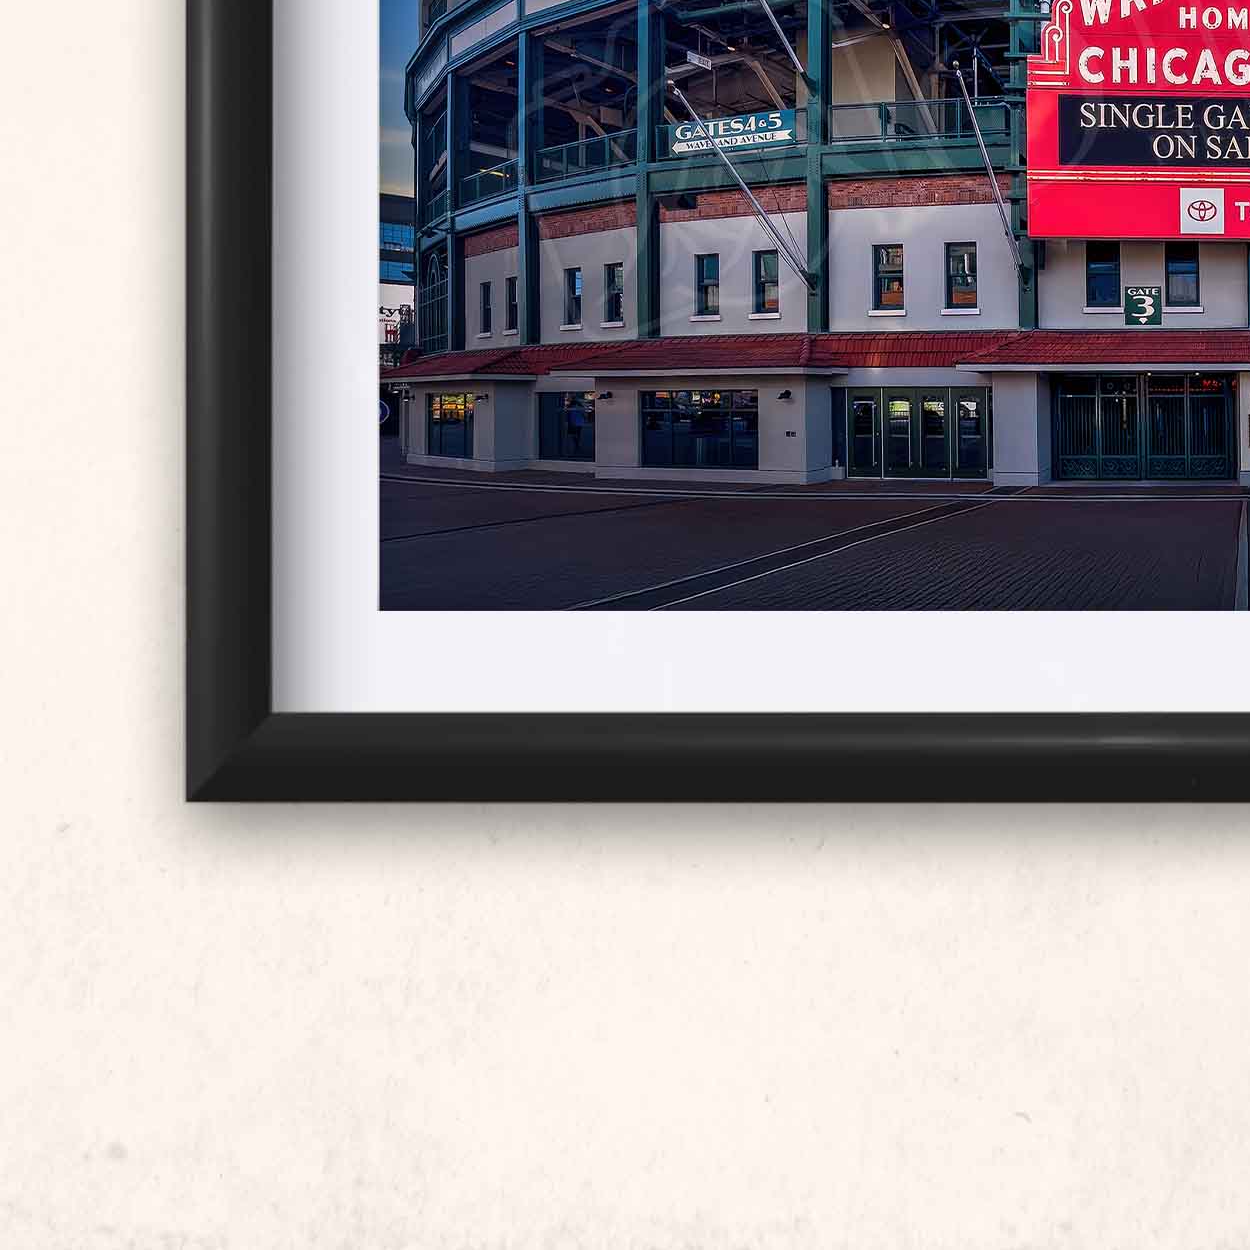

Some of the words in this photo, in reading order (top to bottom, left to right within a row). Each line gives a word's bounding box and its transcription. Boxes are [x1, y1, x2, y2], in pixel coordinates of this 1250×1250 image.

[1080, 102, 1194, 129] SINGLE
[675, 118, 744, 140] GATES
[686, 137, 737, 150] WAVEAND
[740, 132, 777, 144] AVENUE
[1152, 134, 1198, 160] ON
[1128, 288, 1159, 296] GATE
[1131, 295, 1155, 317] 3
